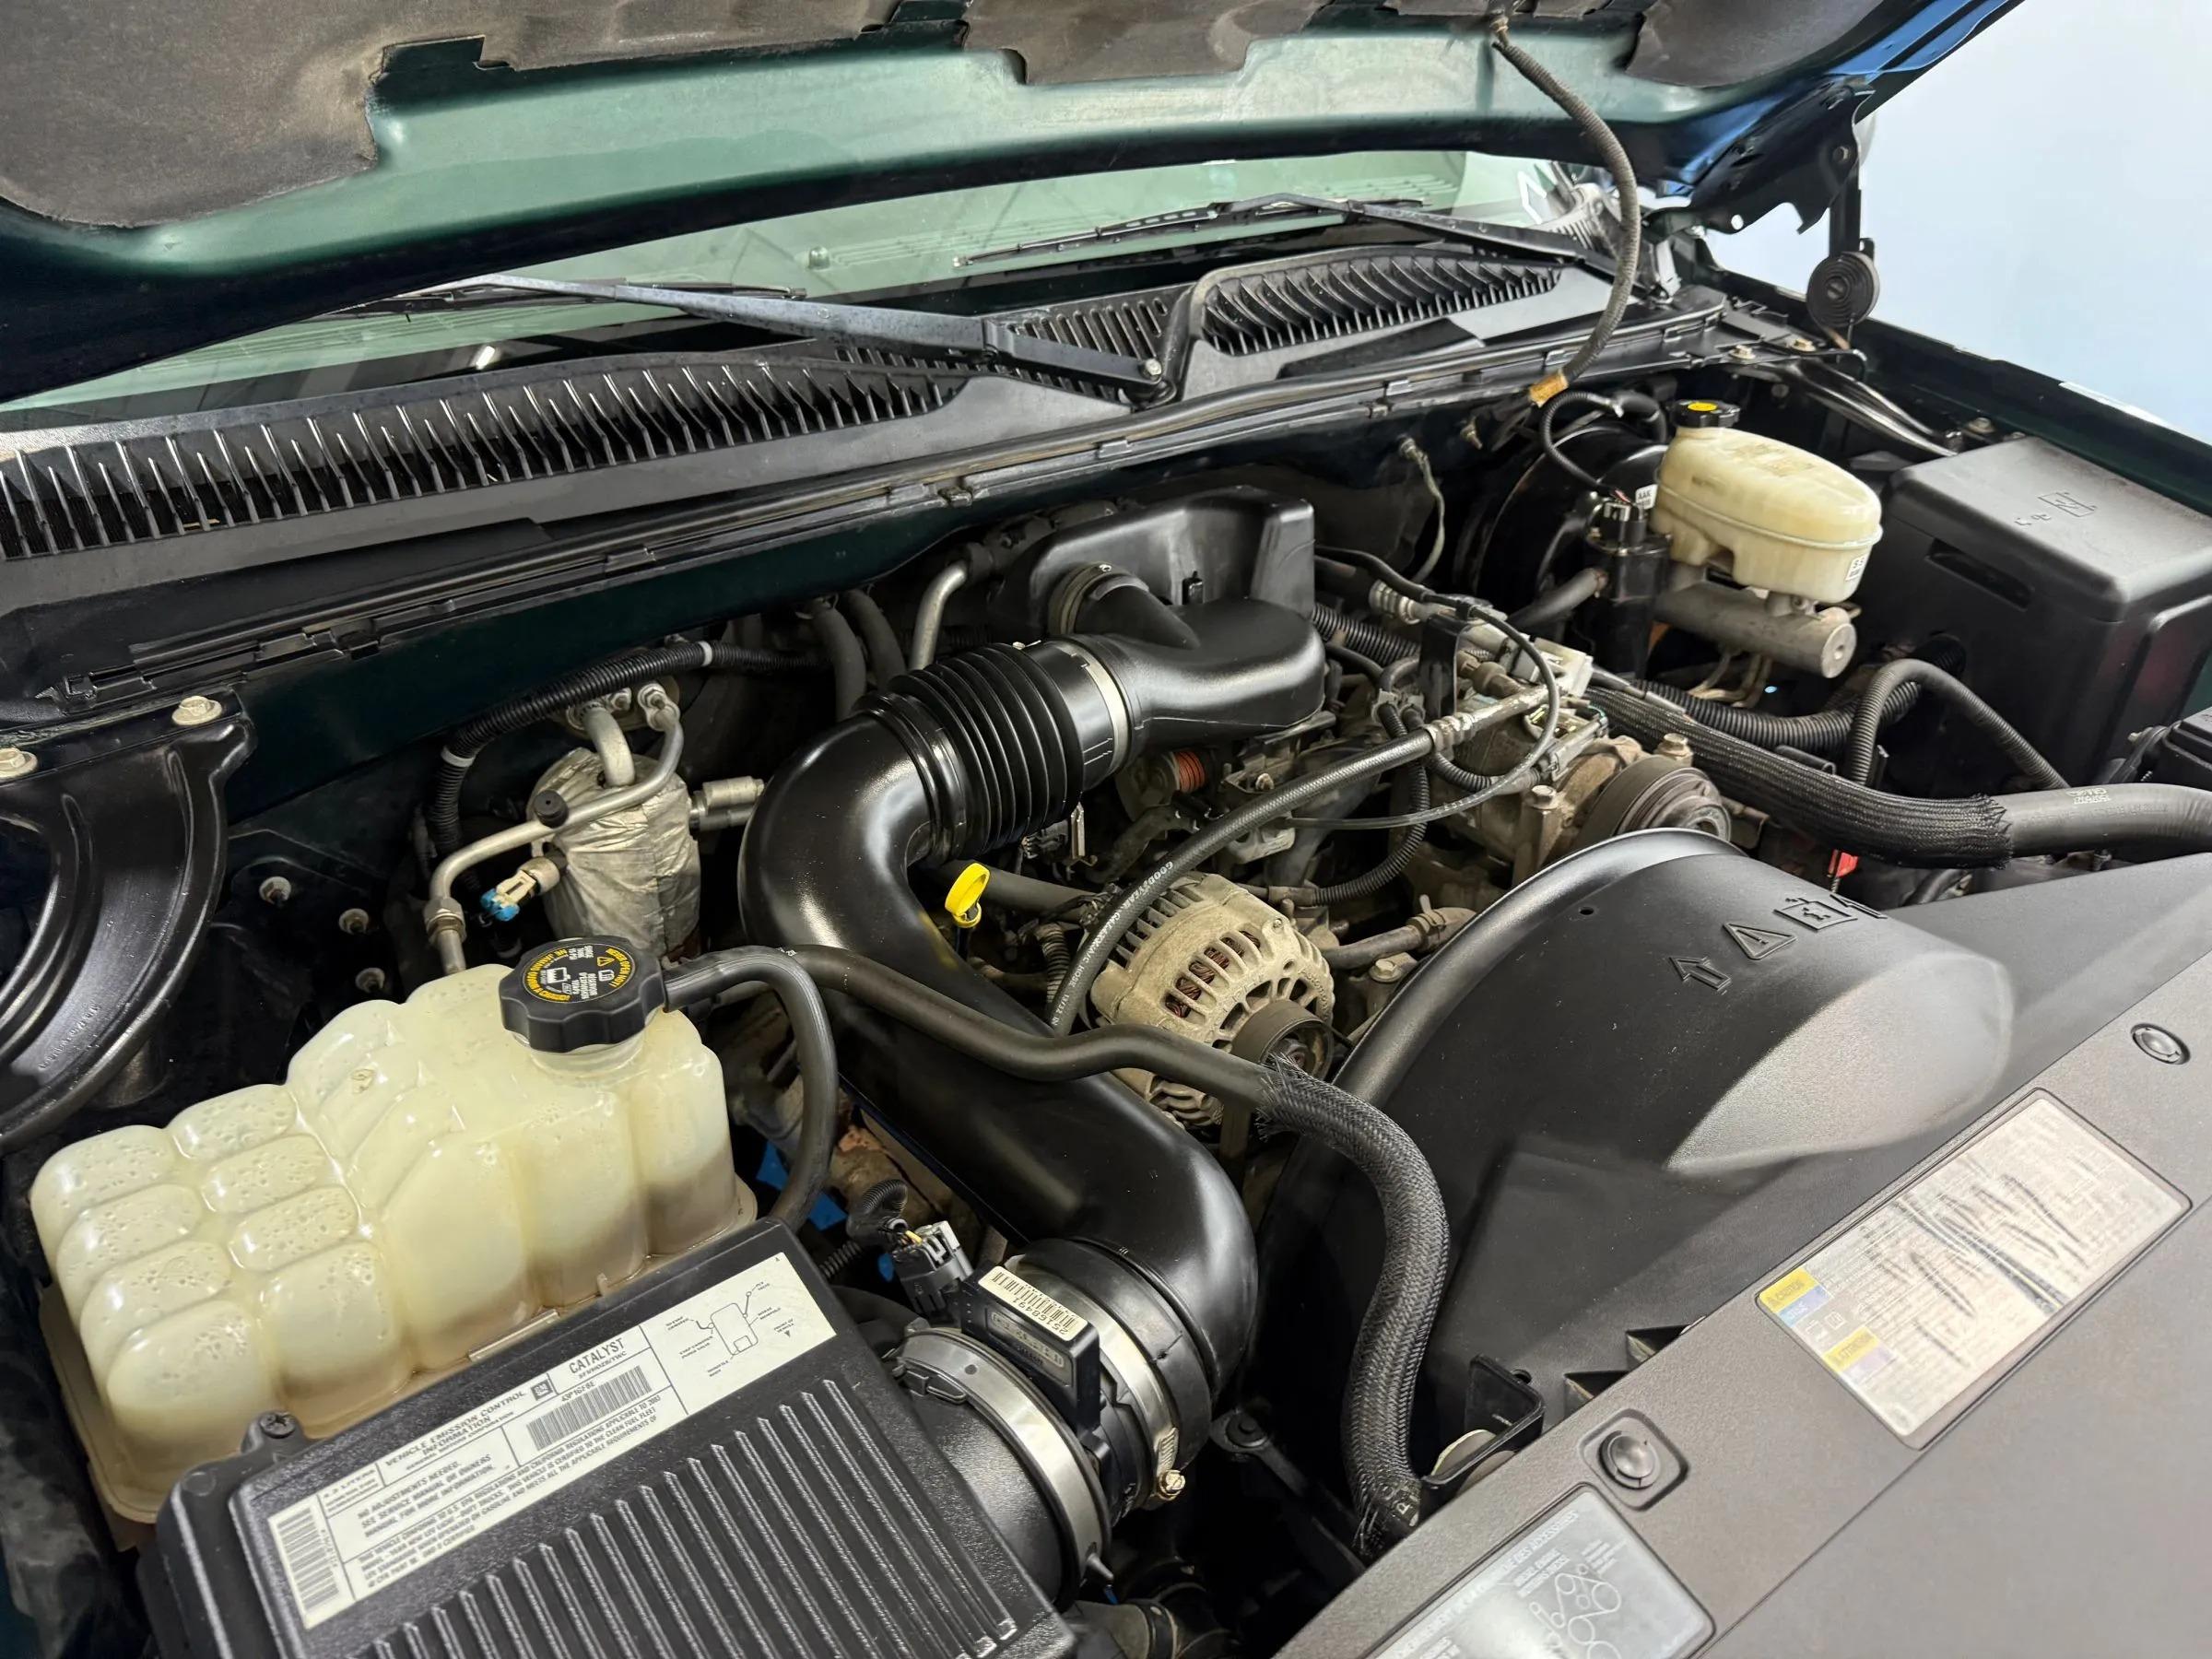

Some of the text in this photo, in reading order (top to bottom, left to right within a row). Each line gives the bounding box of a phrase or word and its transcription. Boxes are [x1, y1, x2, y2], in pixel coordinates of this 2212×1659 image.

[1120, 861, 1174, 910] GOODYEAR
[618, 961, 629, 974] OPEN
[1069, 965, 1085, 987] HOSE
[1012, 1297, 1069, 1335] 25168491
[568, 1336, 626, 1374] CATALYST
[384, 1389, 525, 1466] VEHICLE EMISSION CONTROL
[565, 1425, 605, 1451] REGULATIONS
[605, 1406, 639, 1429] APPLICABLE
[638, 1406, 656, 1419] FLEET
[422, 1415, 491, 1455] INFORMATION
[360, 1514, 376, 1529] SEE
[377, 1496, 412, 1520] SERVICE
[412, 1478, 445, 1501] MANUAL
[370, 1477, 428, 1512] ADJUSTMENTS
[364, 1514, 398, 1538] MANUAL
